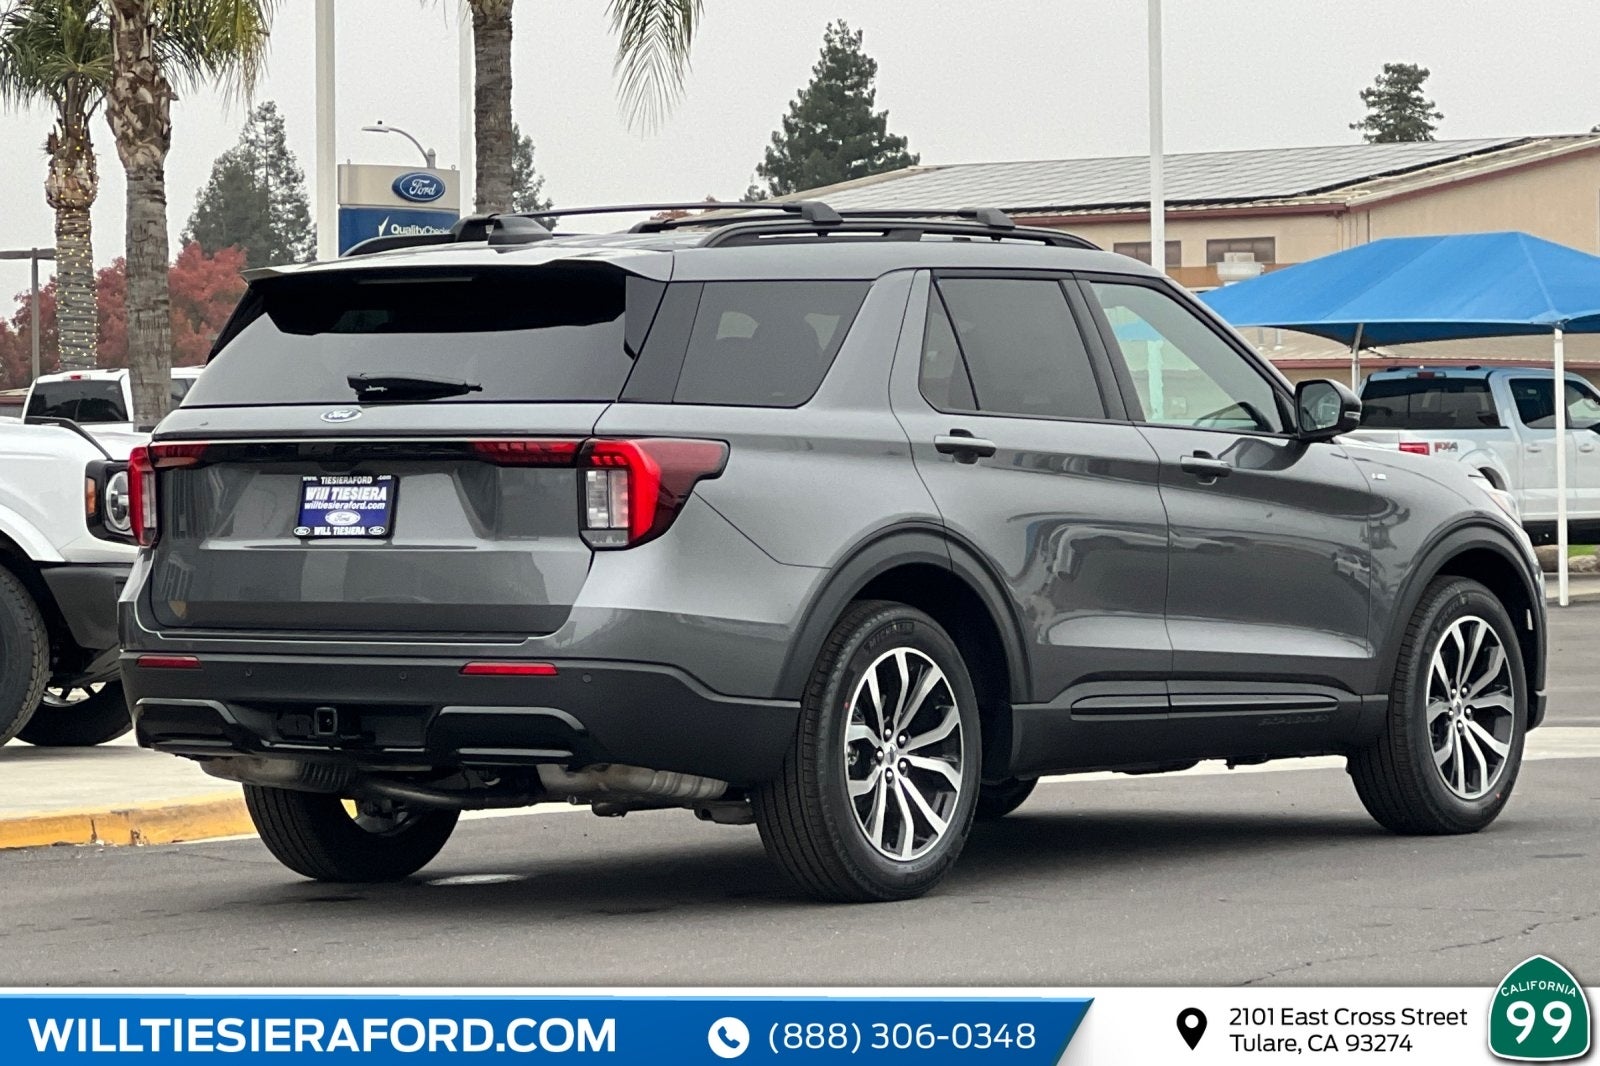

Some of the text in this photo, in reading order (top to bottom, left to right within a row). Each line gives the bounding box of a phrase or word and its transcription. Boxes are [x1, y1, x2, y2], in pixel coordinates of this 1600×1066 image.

[409, 178, 437, 196] Ford
[321, 476, 373, 484] TIESIERAFORD
[331, 486, 387, 500] TIESIERA
[304, 501, 385, 509] willtiesieraford.com
[314, 526, 331, 535] WILL
[333, 526, 365, 535] TIESIERA
